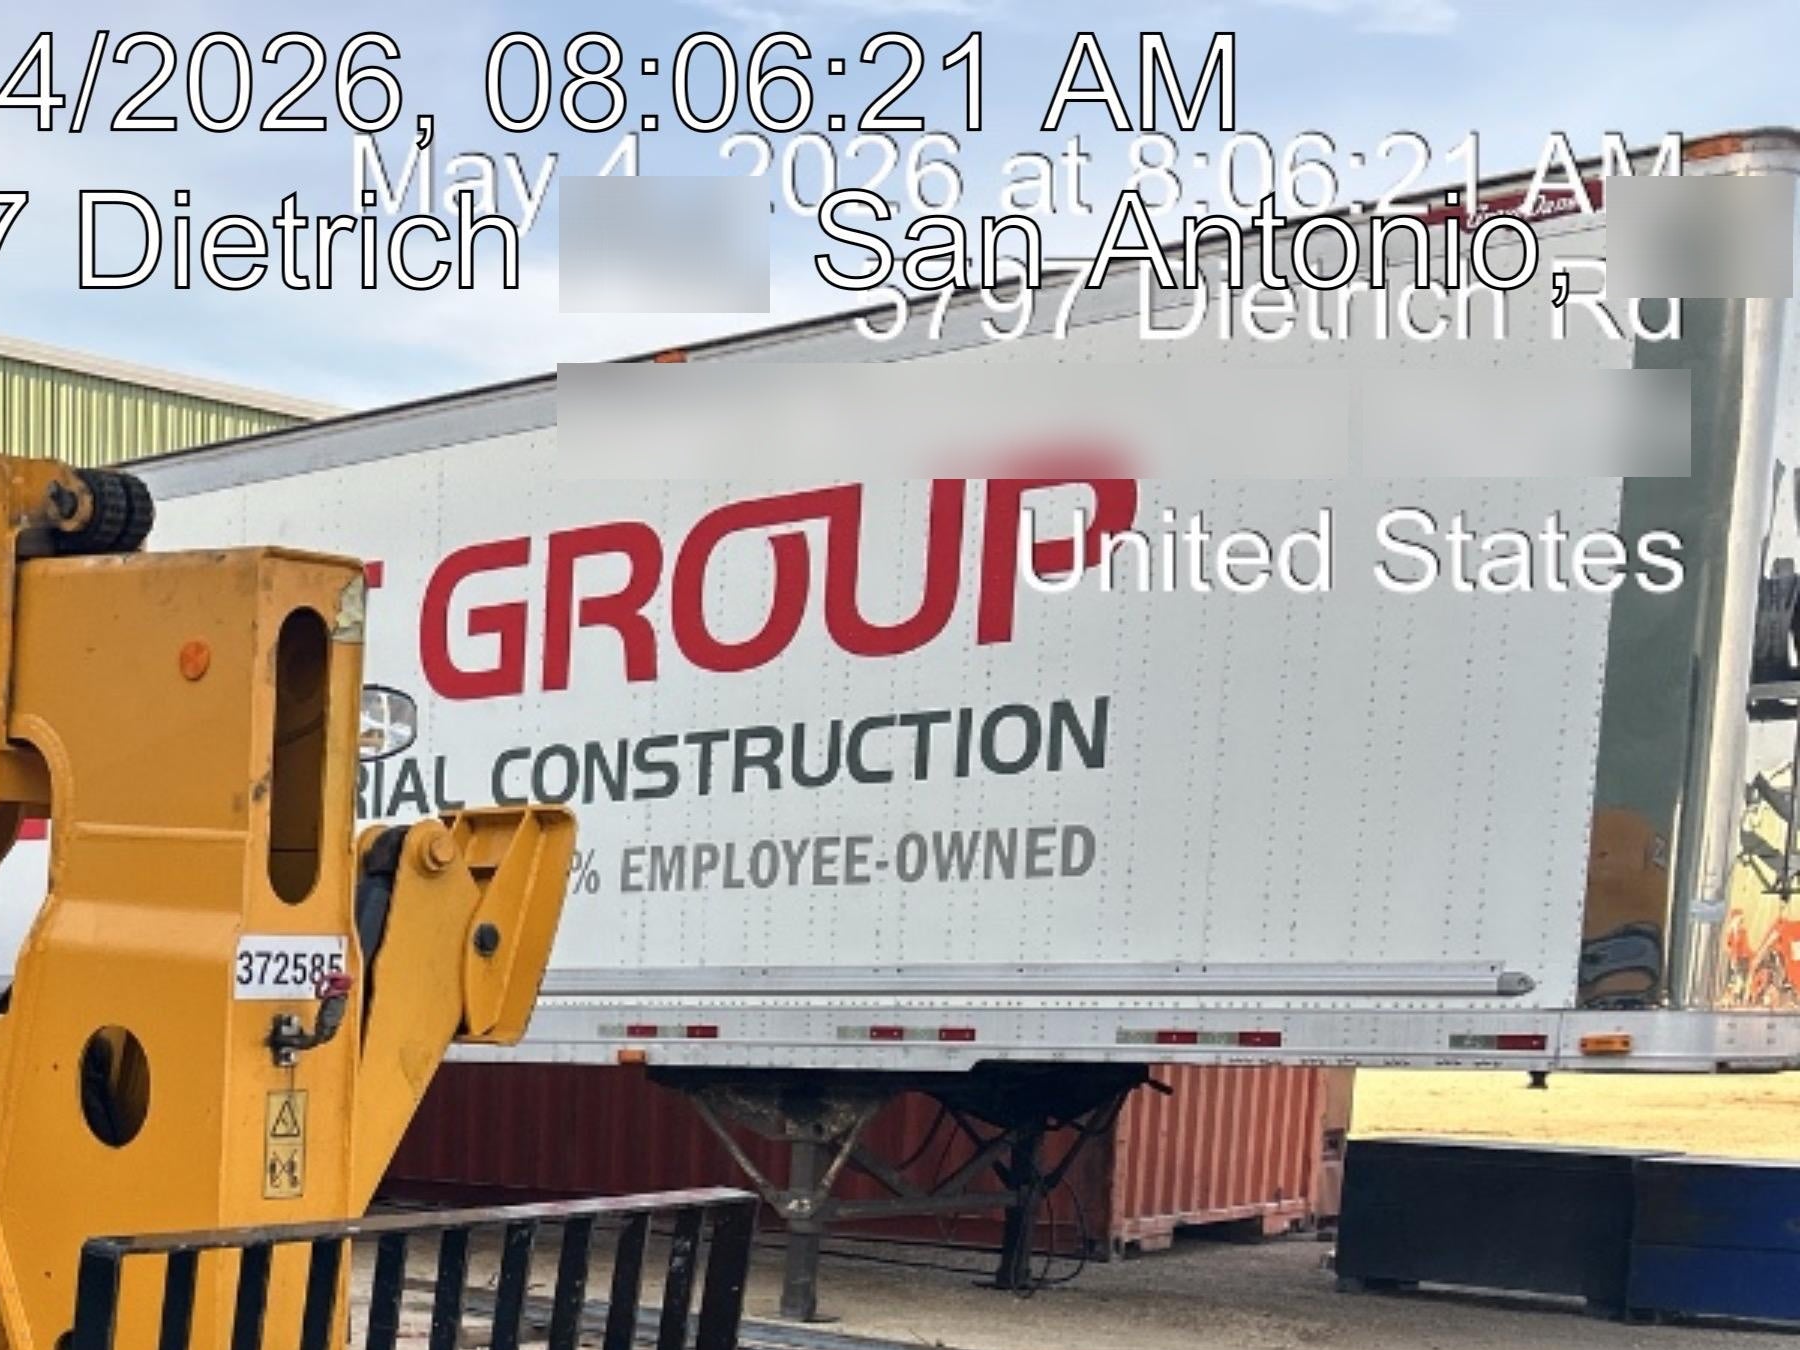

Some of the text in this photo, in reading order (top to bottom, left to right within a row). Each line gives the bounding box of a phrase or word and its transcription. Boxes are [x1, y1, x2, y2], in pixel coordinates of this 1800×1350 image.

[419, 473, 1139, 701] GROUP
[491, 695, 1112, 805] CONSTRUCTION
[619, 823, 1097, 894] EMPLOYEE-OWNED
